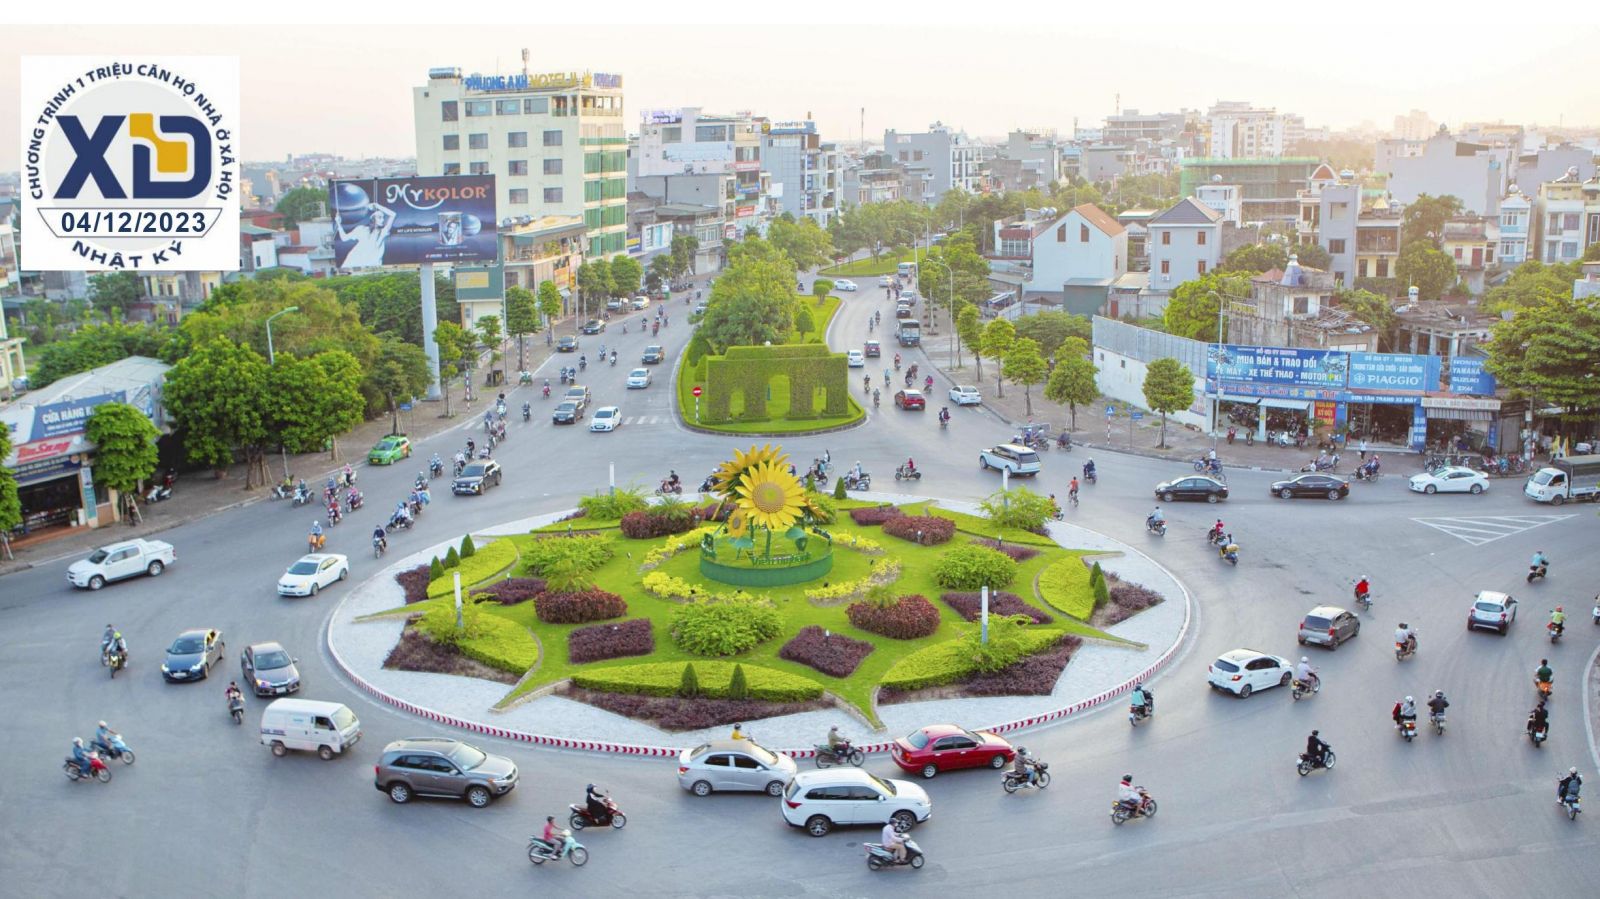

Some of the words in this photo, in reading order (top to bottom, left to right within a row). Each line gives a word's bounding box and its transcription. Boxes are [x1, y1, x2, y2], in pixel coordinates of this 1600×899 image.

[1237, 355, 1254, 364] MUA
[1257, 354, 1271, 366] BÁN
[1281, 358, 1301, 368] TRAO
[1248, 368, 1258, 377] XE
[1275, 370, 1294, 379] THAO
[1301, 372, 1327, 381] MOTOR
[1453, 367, 1481, 375] YAMAHA
[1368, 374, 1419, 385] PIAGGIO
[42, 409, 60, 424] CỬA
[61, 406, 84, 420] HÀNG
